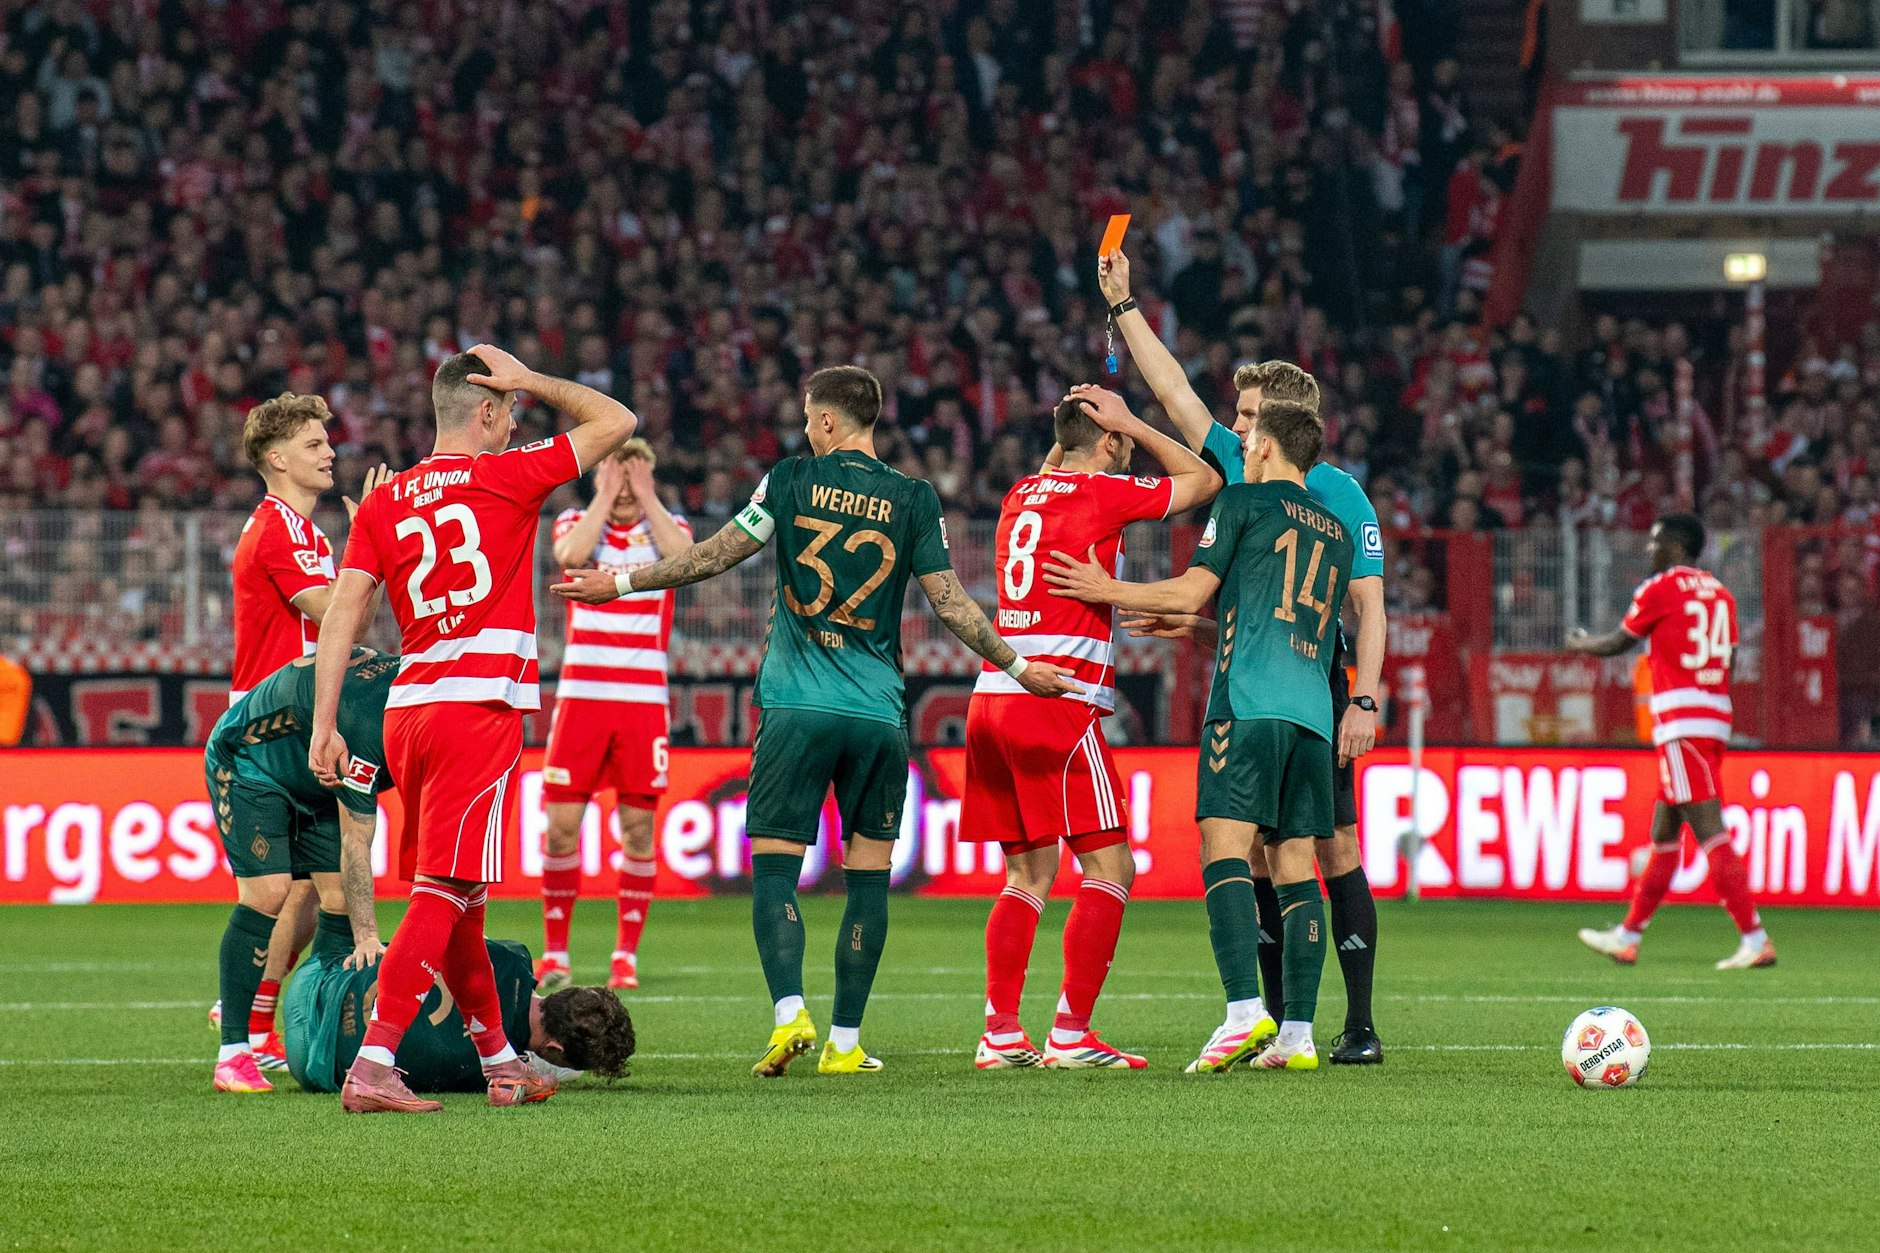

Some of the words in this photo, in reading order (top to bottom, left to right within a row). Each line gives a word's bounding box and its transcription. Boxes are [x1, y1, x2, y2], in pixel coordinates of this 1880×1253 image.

[404, 479, 420, 498] FC
[424, 468, 472, 491] UNION
[413, 488, 443, 508] BERLIN
[811, 484, 893, 524] WERDER
[1280, 499, 1344, 542] WERDER
[395, 503, 493, 620] 23
[784, 515, 897, 631] 32
[1004, 510, 1042, 601] 8
[1274, 528, 1339, 641] 14
[1680, 600, 1732, 669] 34
[652, 736, 669, 772] 6
[1361, 764, 1631, 892] REWE
[1579, 1038, 1625, 1072] DERBYSTAR
